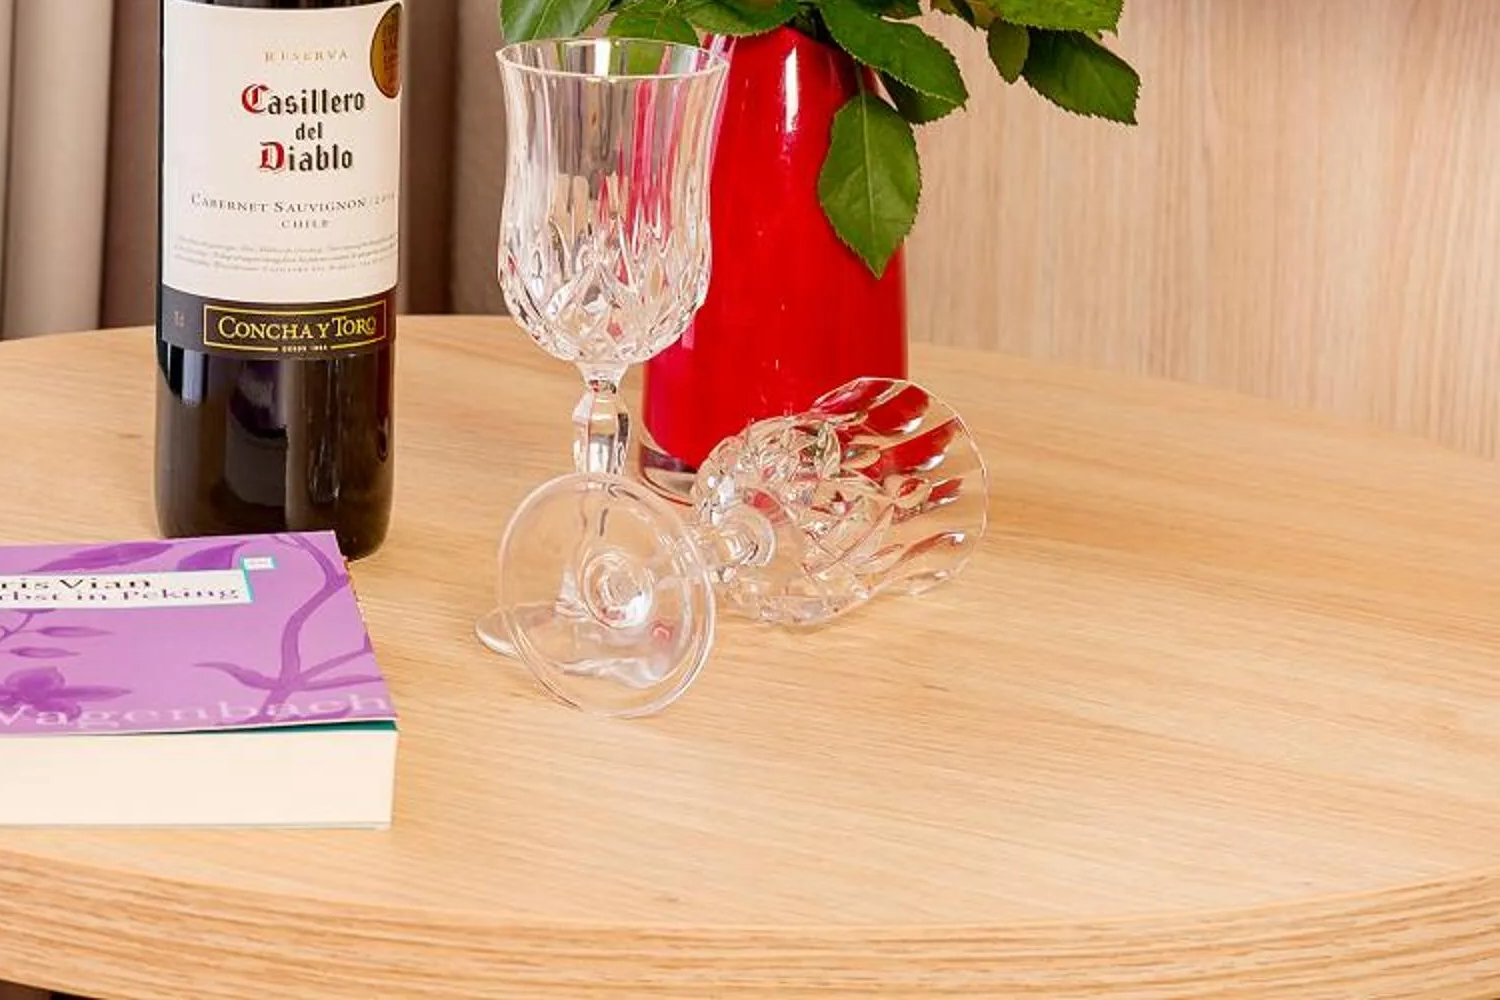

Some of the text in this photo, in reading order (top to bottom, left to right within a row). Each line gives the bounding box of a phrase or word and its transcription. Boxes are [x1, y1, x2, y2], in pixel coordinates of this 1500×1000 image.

[241, 83, 366, 115] Casillero
[295, 122, 323, 140] del
[259, 142, 354, 173] Diablo
[191, 193, 366, 213] CABERNET SAUVIGNON
[218, 315, 377, 340] CONCHA Y TORO
[59, 577, 151, 590] Vian
[76, 590, 111, 601] in
[123, 589, 239, 600] Peking
